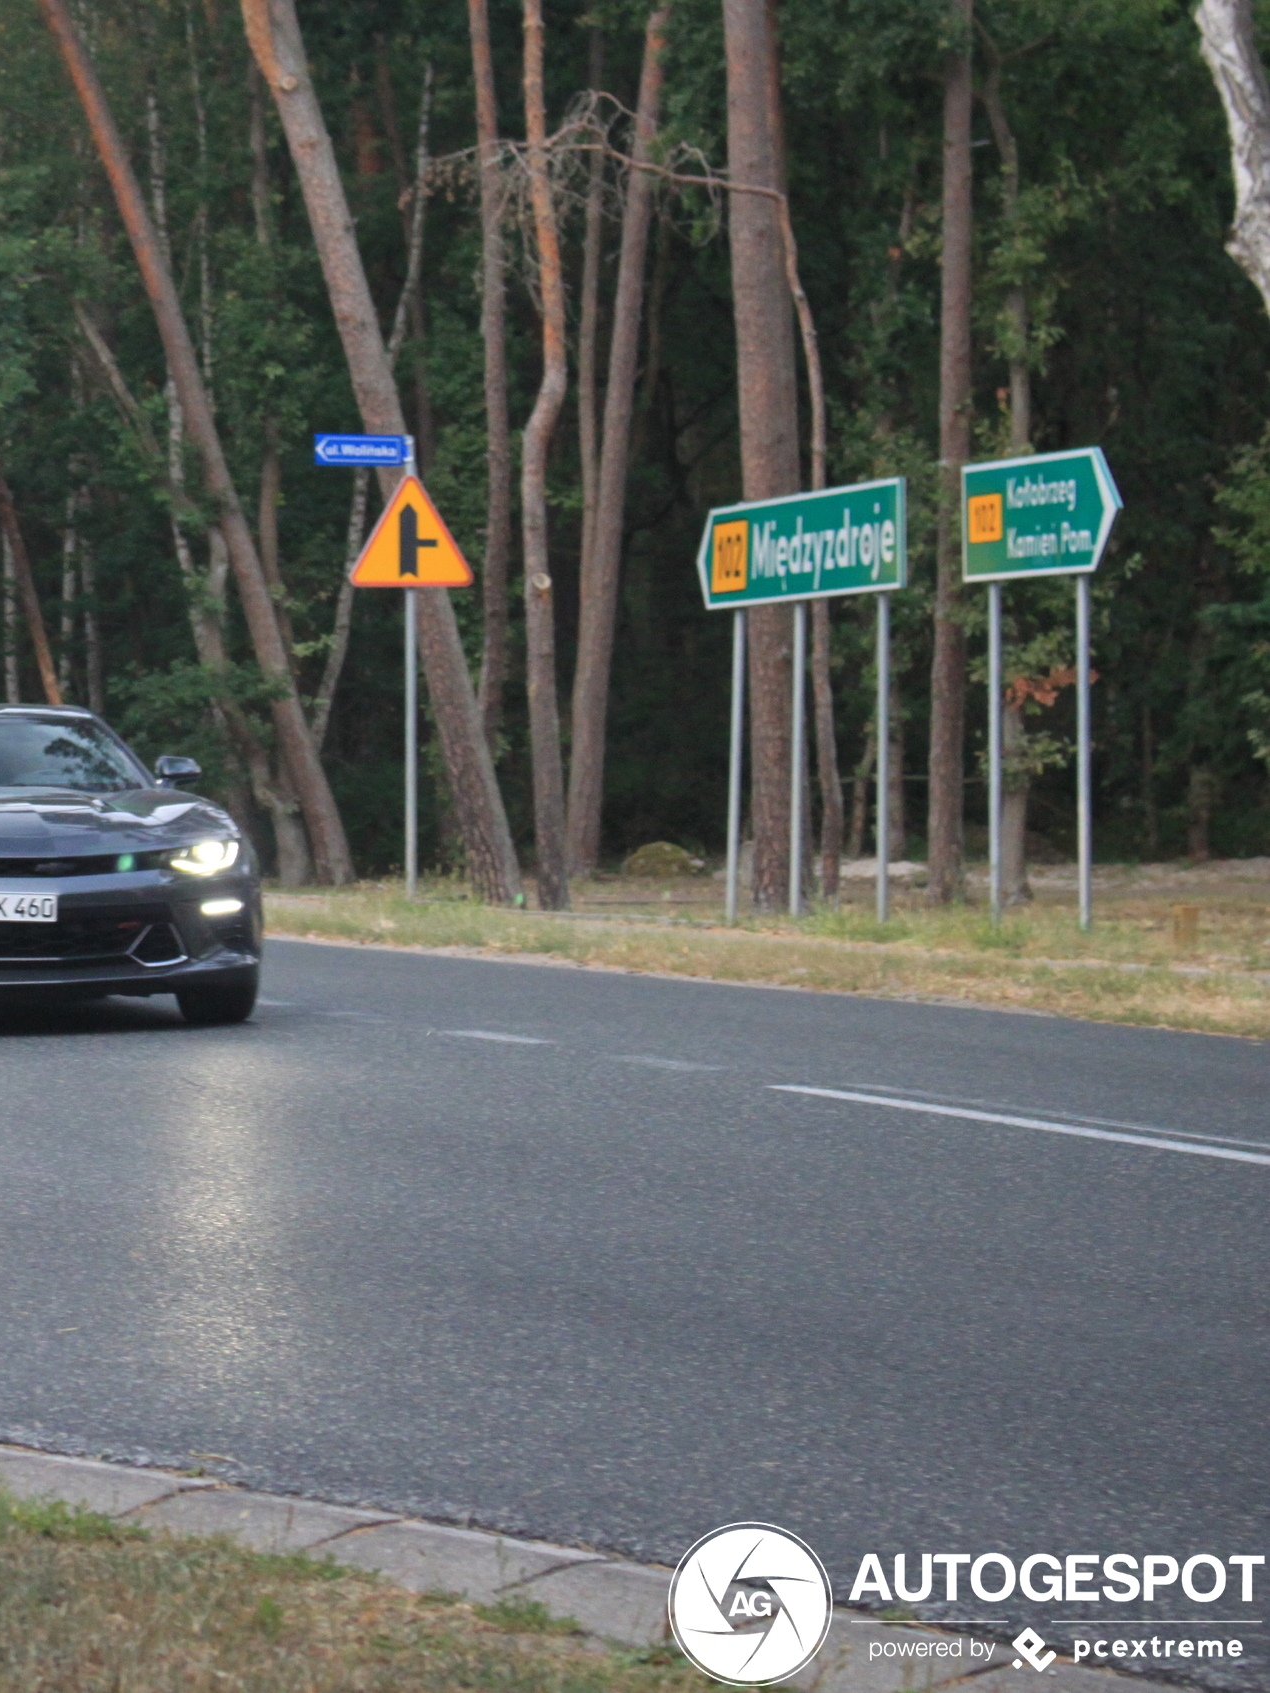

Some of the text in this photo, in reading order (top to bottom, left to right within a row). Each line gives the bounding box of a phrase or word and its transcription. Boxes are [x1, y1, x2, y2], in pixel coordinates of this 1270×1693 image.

[973, 503, 996, 533] 102
[717, 502, 895, 592] 102 Międzyzdroje
[1060, 521, 1095, 554] Pom.
[14, 897, 53, 919] 460
